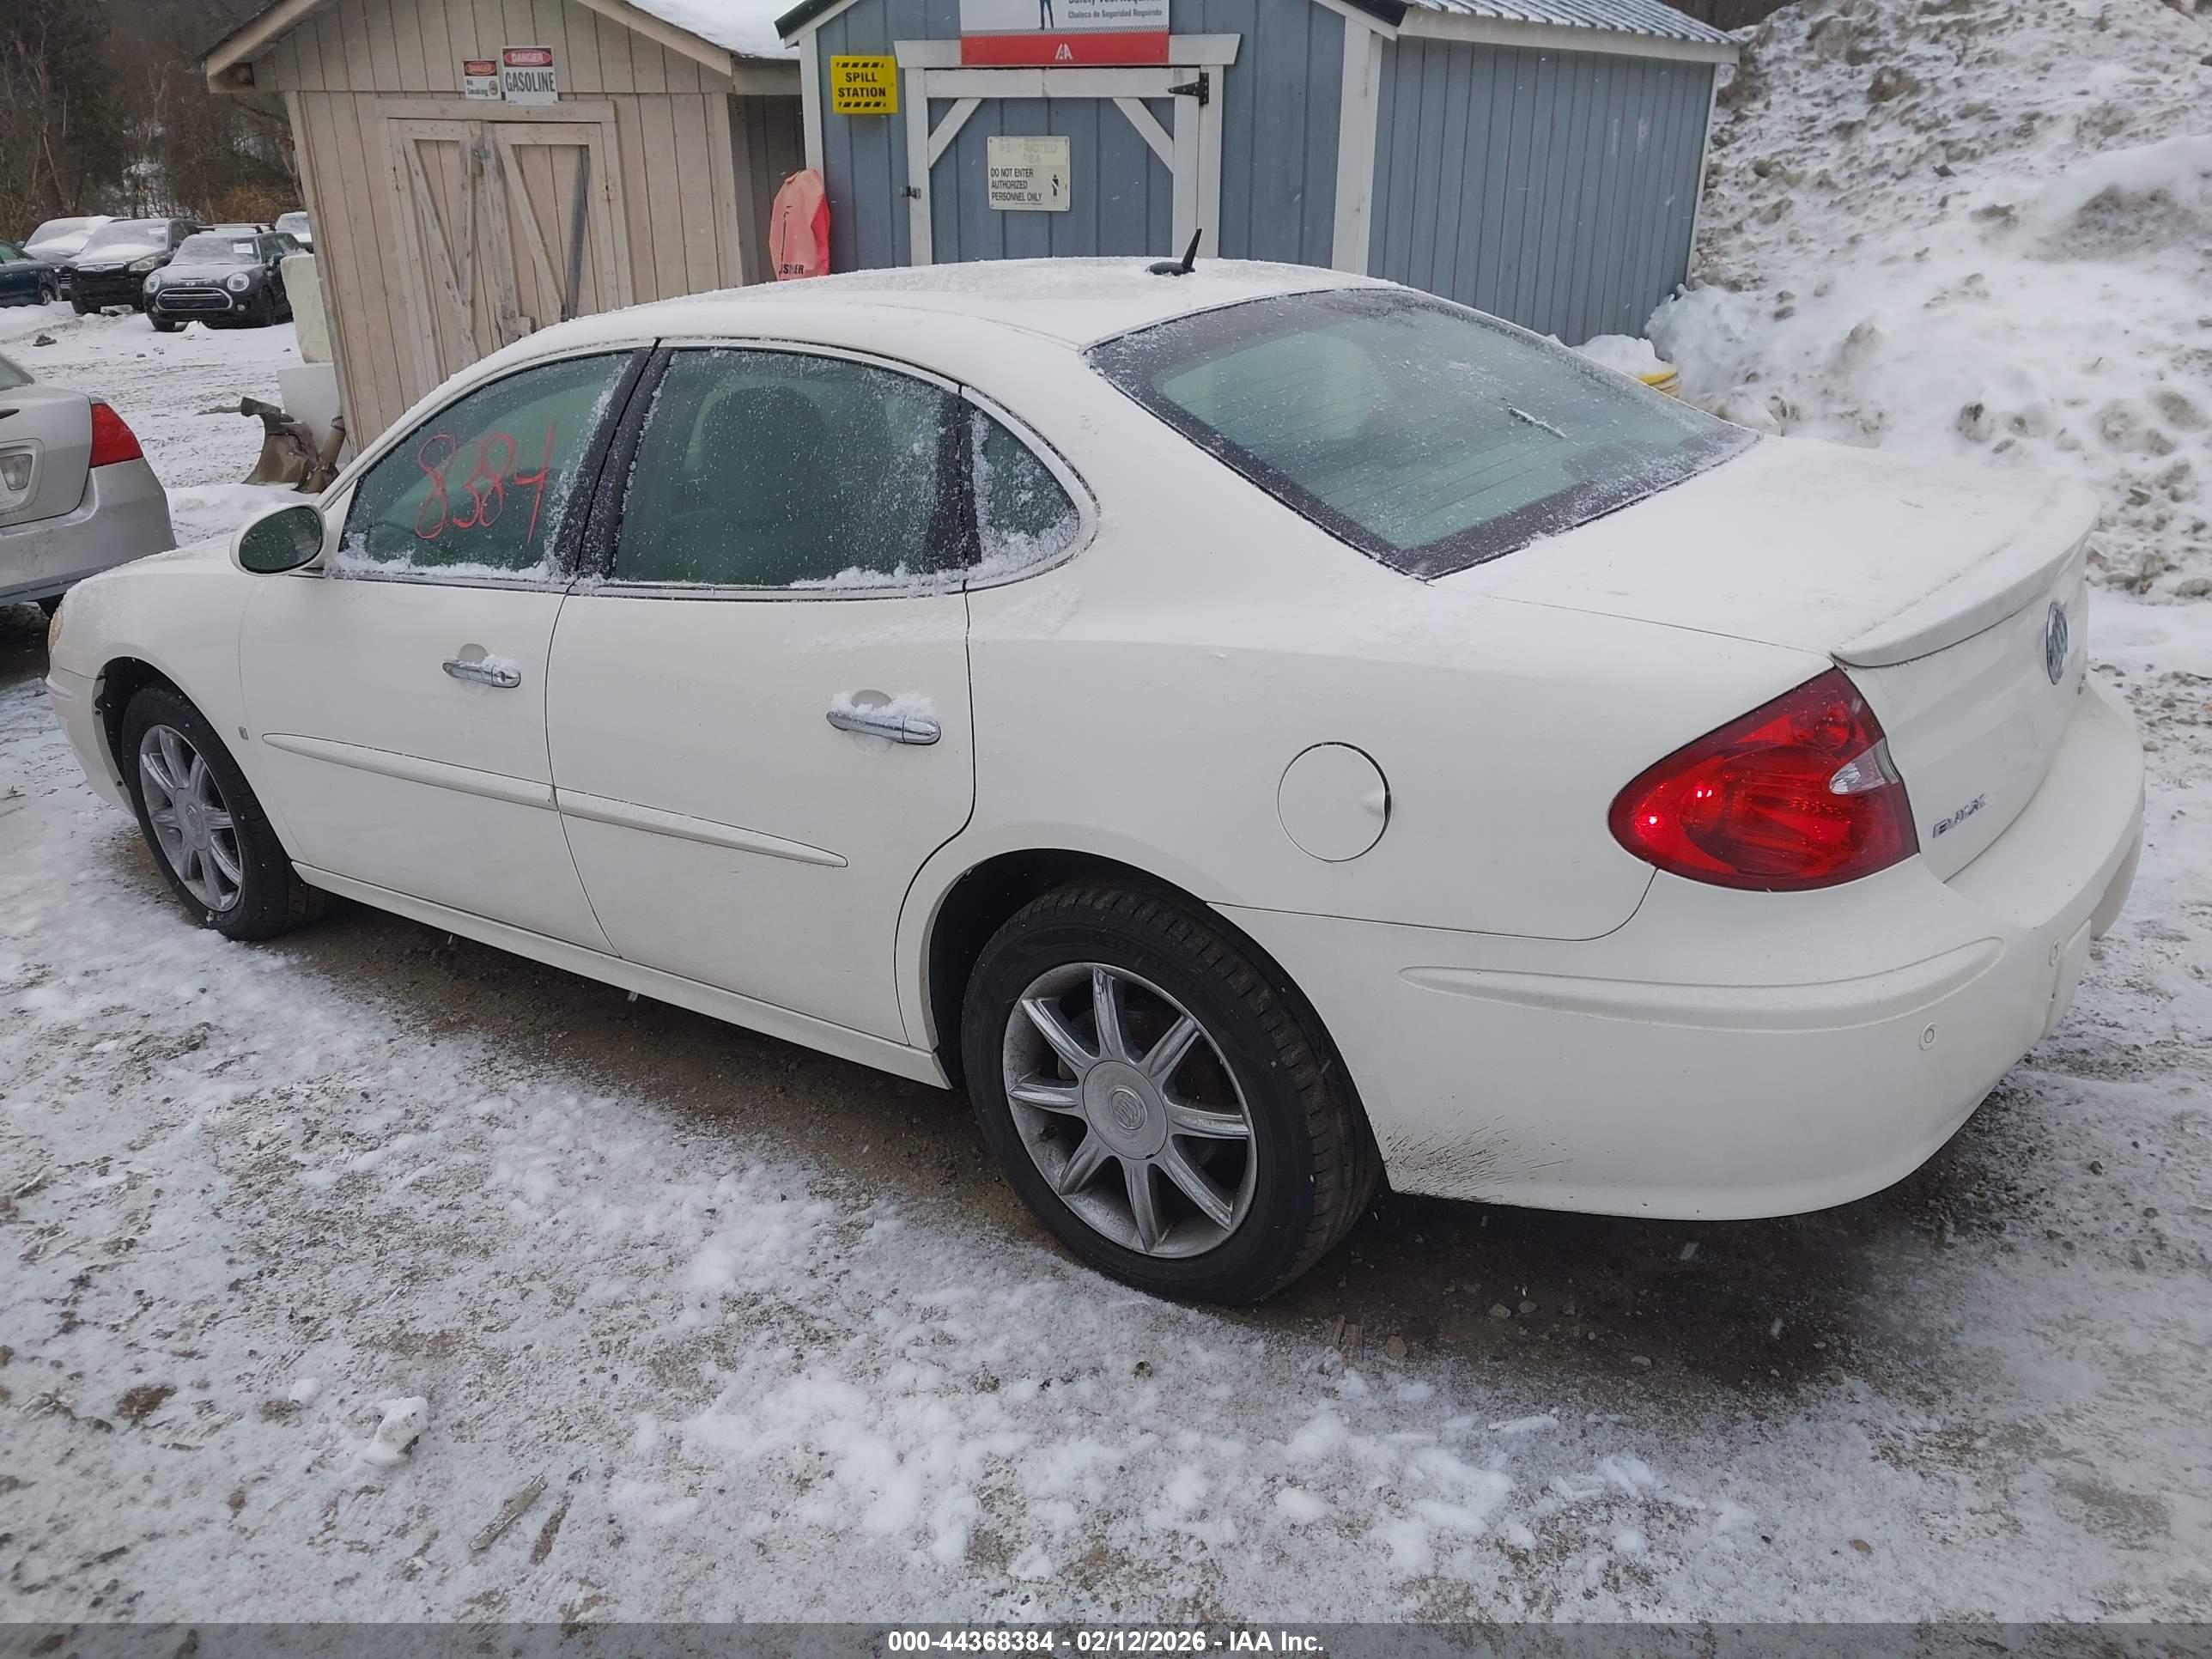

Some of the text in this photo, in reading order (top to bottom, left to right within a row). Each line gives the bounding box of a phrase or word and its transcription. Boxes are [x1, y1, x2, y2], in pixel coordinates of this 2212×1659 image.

[505, 71, 556, 92] GASOLINE
[845, 71, 878, 82] SPILL
[838, 87, 886, 98] STATION
[990, 167, 1034, 178] DO NOT ENTER
[991, 179, 1028, 190] AUTHORIZED
[991, 191, 1042, 202] PERSONNEL ONLY
